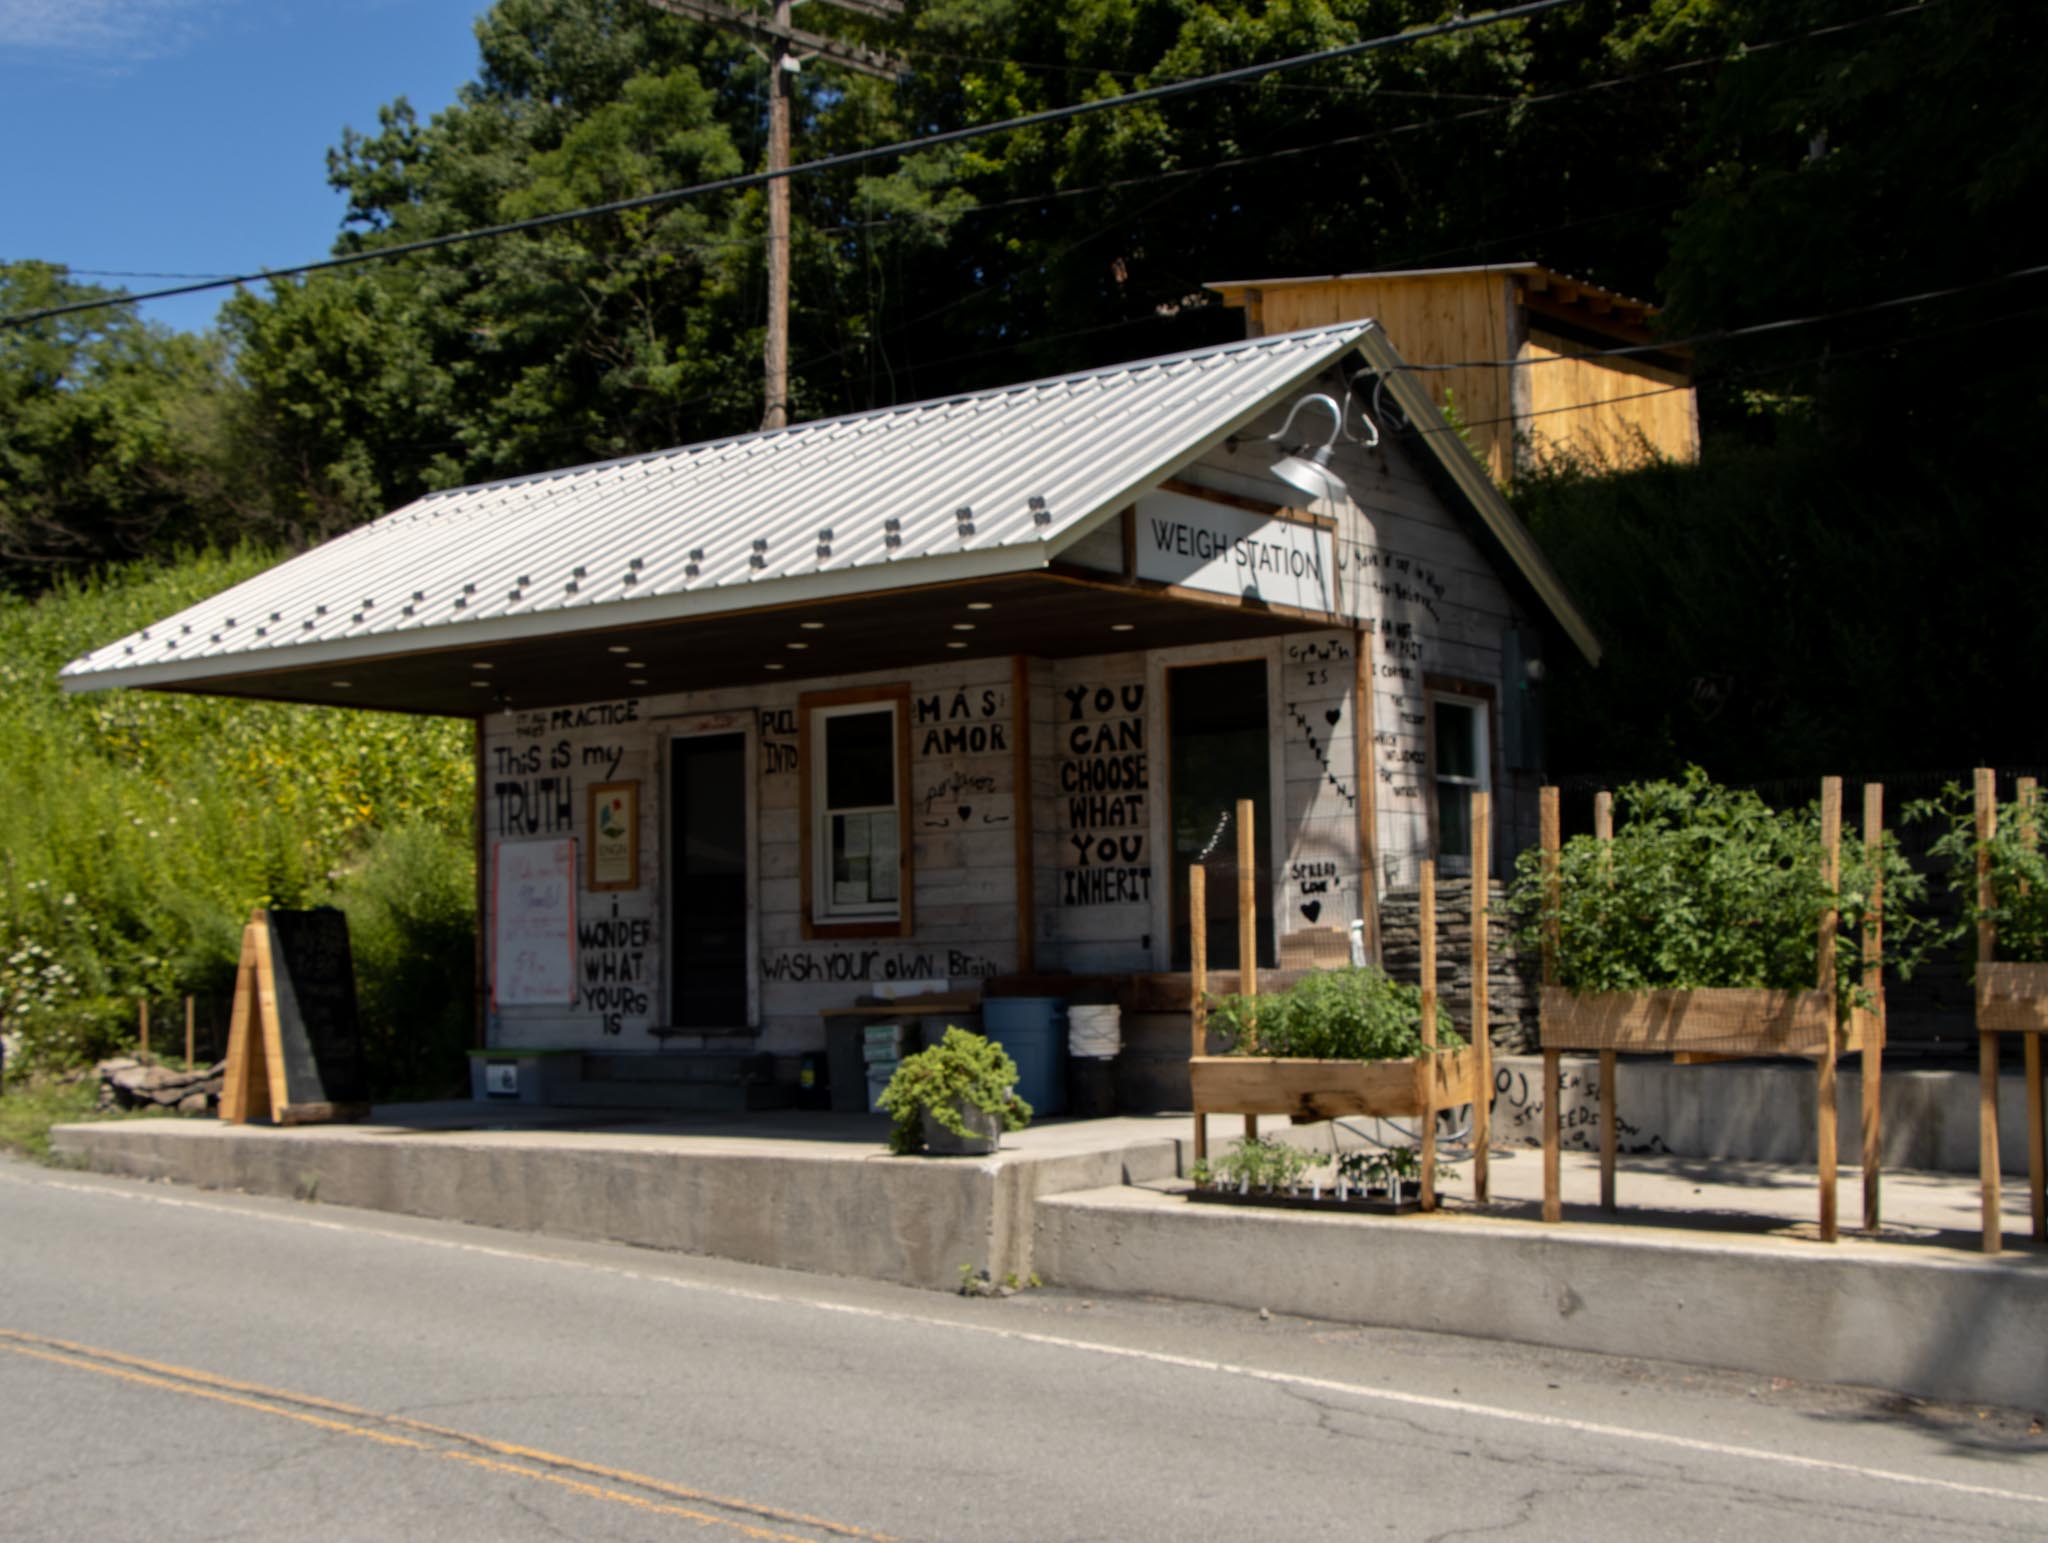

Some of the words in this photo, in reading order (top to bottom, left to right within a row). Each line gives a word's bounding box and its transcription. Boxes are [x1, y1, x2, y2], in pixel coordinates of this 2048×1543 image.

[1152, 518, 1229, 563] WEIGH
[1234, 537, 1320, 581] STATION
[1307, 670, 1328, 686] IS
[551, 700, 639, 731] PRACTICE
[1065, 684, 1144, 720] YOU
[922, 723, 1007, 755] AMOR
[1070, 719, 1142, 754] CAN
[1062, 755, 1149, 792] CHOOSE
[495, 776, 573, 837] TRUTH
[1070, 795, 1144, 829] WHAT
[1071, 834, 1143, 866] YOU
[1065, 868, 1152, 905] INHERIT
[578, 920, 651, 949] WONDER
[586, 953, 643, 982] WHAT
[583, 987, 649, 1014] YOURS
[604, 1013, 623, 1035] IS
